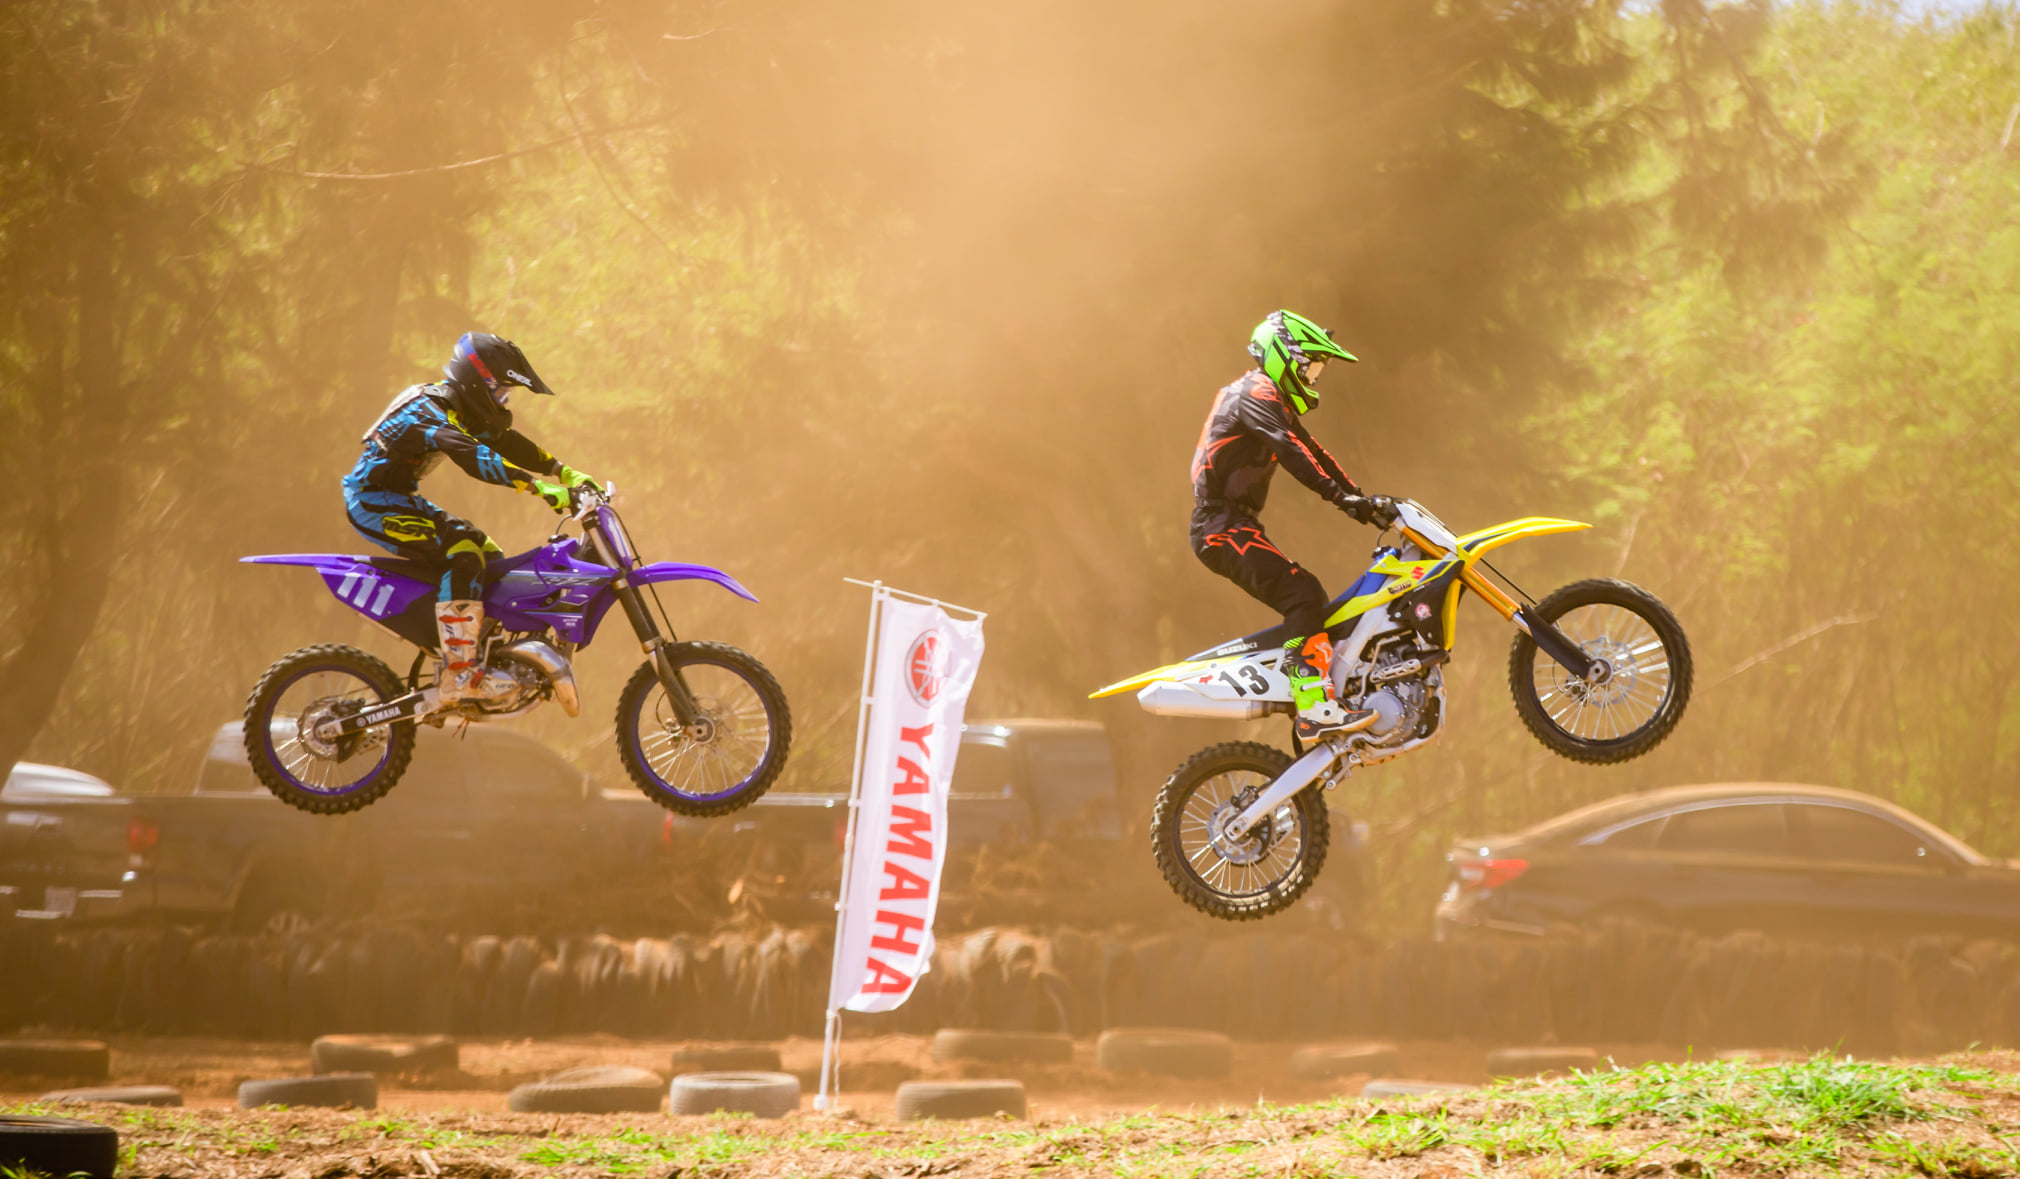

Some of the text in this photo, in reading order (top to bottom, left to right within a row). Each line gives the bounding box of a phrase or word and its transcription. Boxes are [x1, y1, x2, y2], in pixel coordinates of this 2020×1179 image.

[337, 573, 395, 617] 111
[1216, 642, 1258, 656] SUZUKI
[1219, 665, 1269, 697] 13
[366, 706, 402, 725] YAMAHA
[861, 722, 935, 995] YAMAHA
